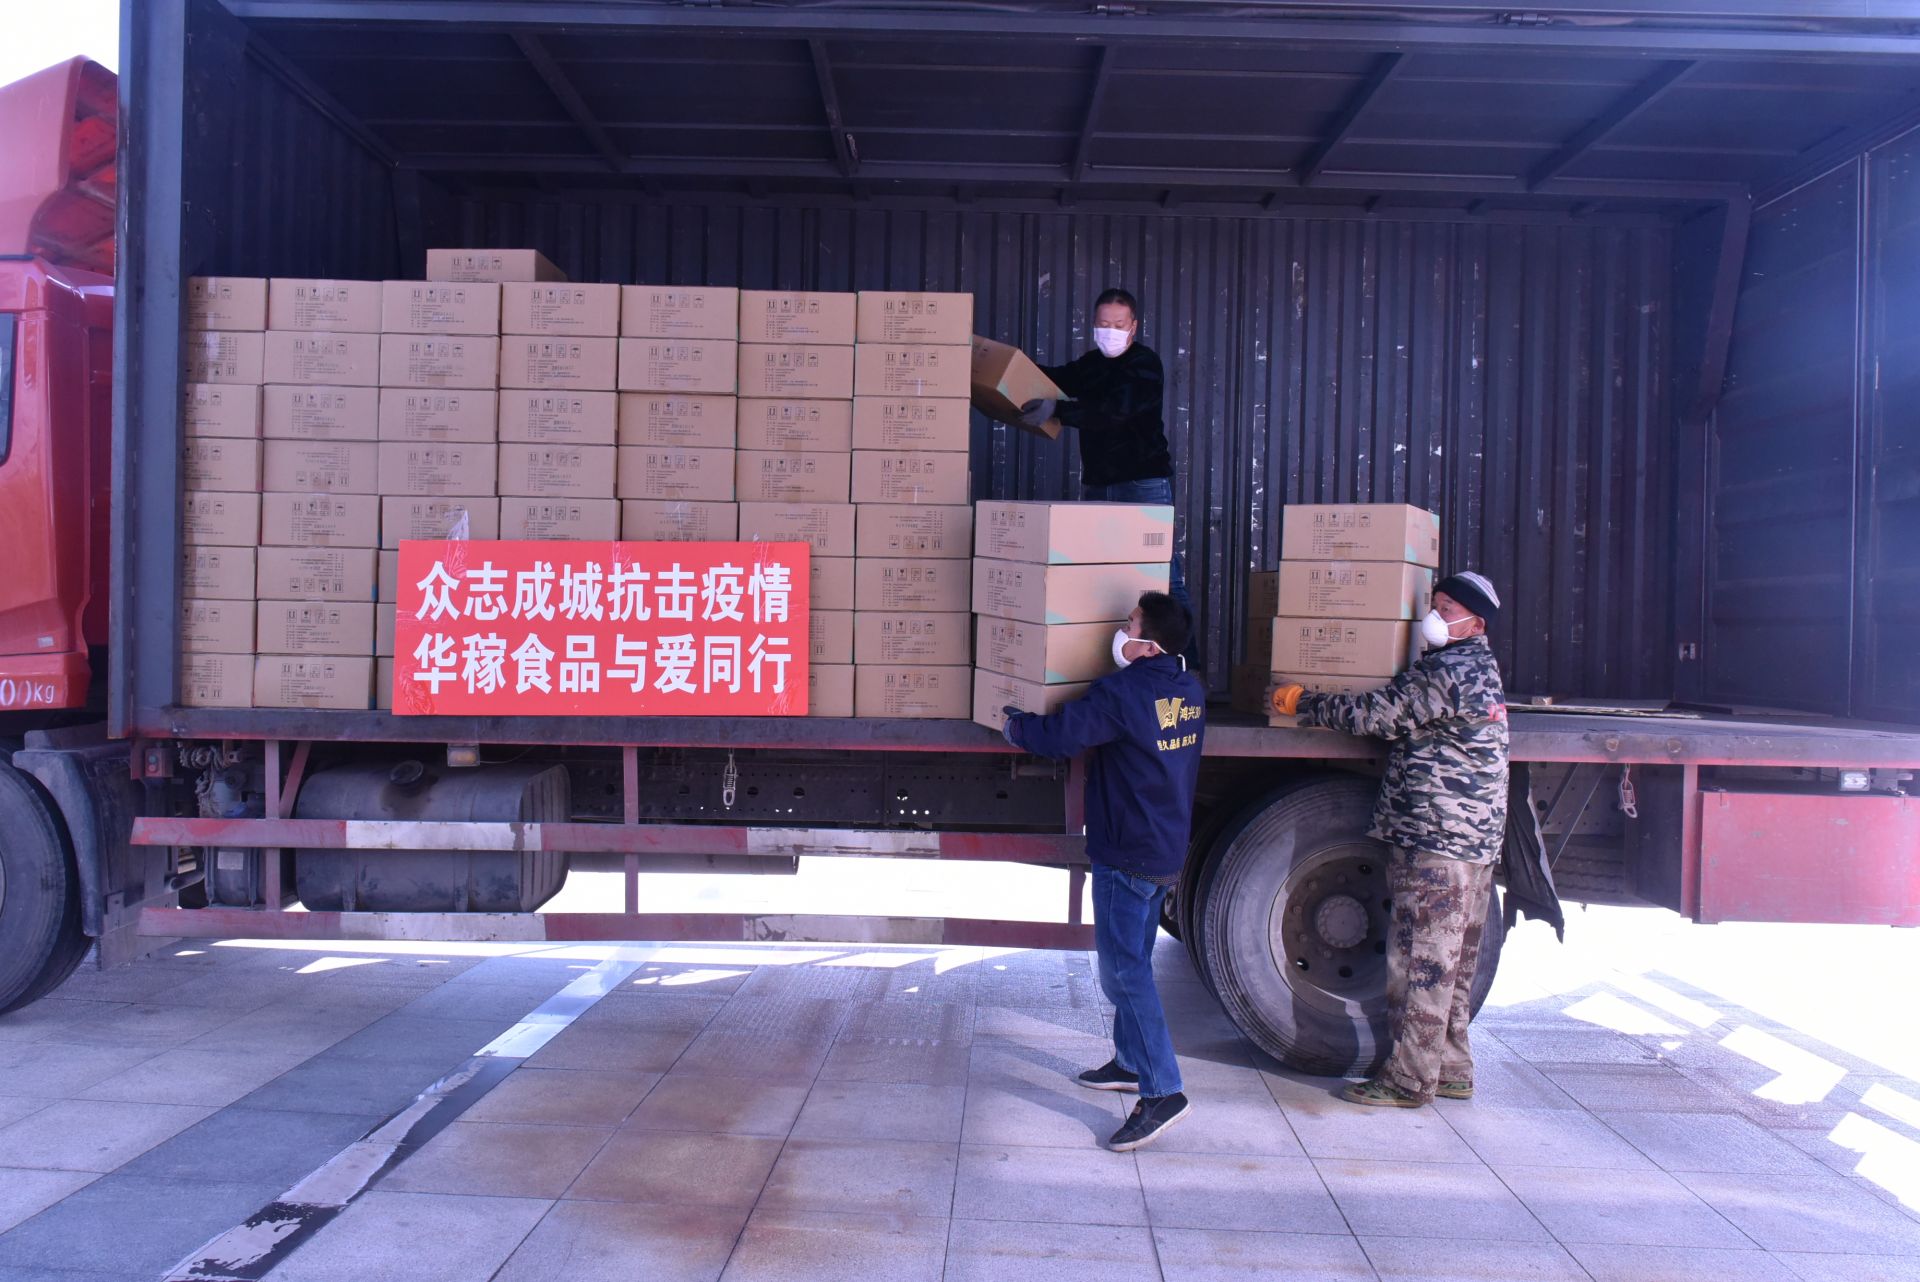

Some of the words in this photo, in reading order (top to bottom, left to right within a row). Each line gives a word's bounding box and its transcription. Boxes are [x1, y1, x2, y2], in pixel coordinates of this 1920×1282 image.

[415, 560, 792, 624] 众志成城抗击疫情
[413, 632, 792, 695] 华稼食品与爱同行
